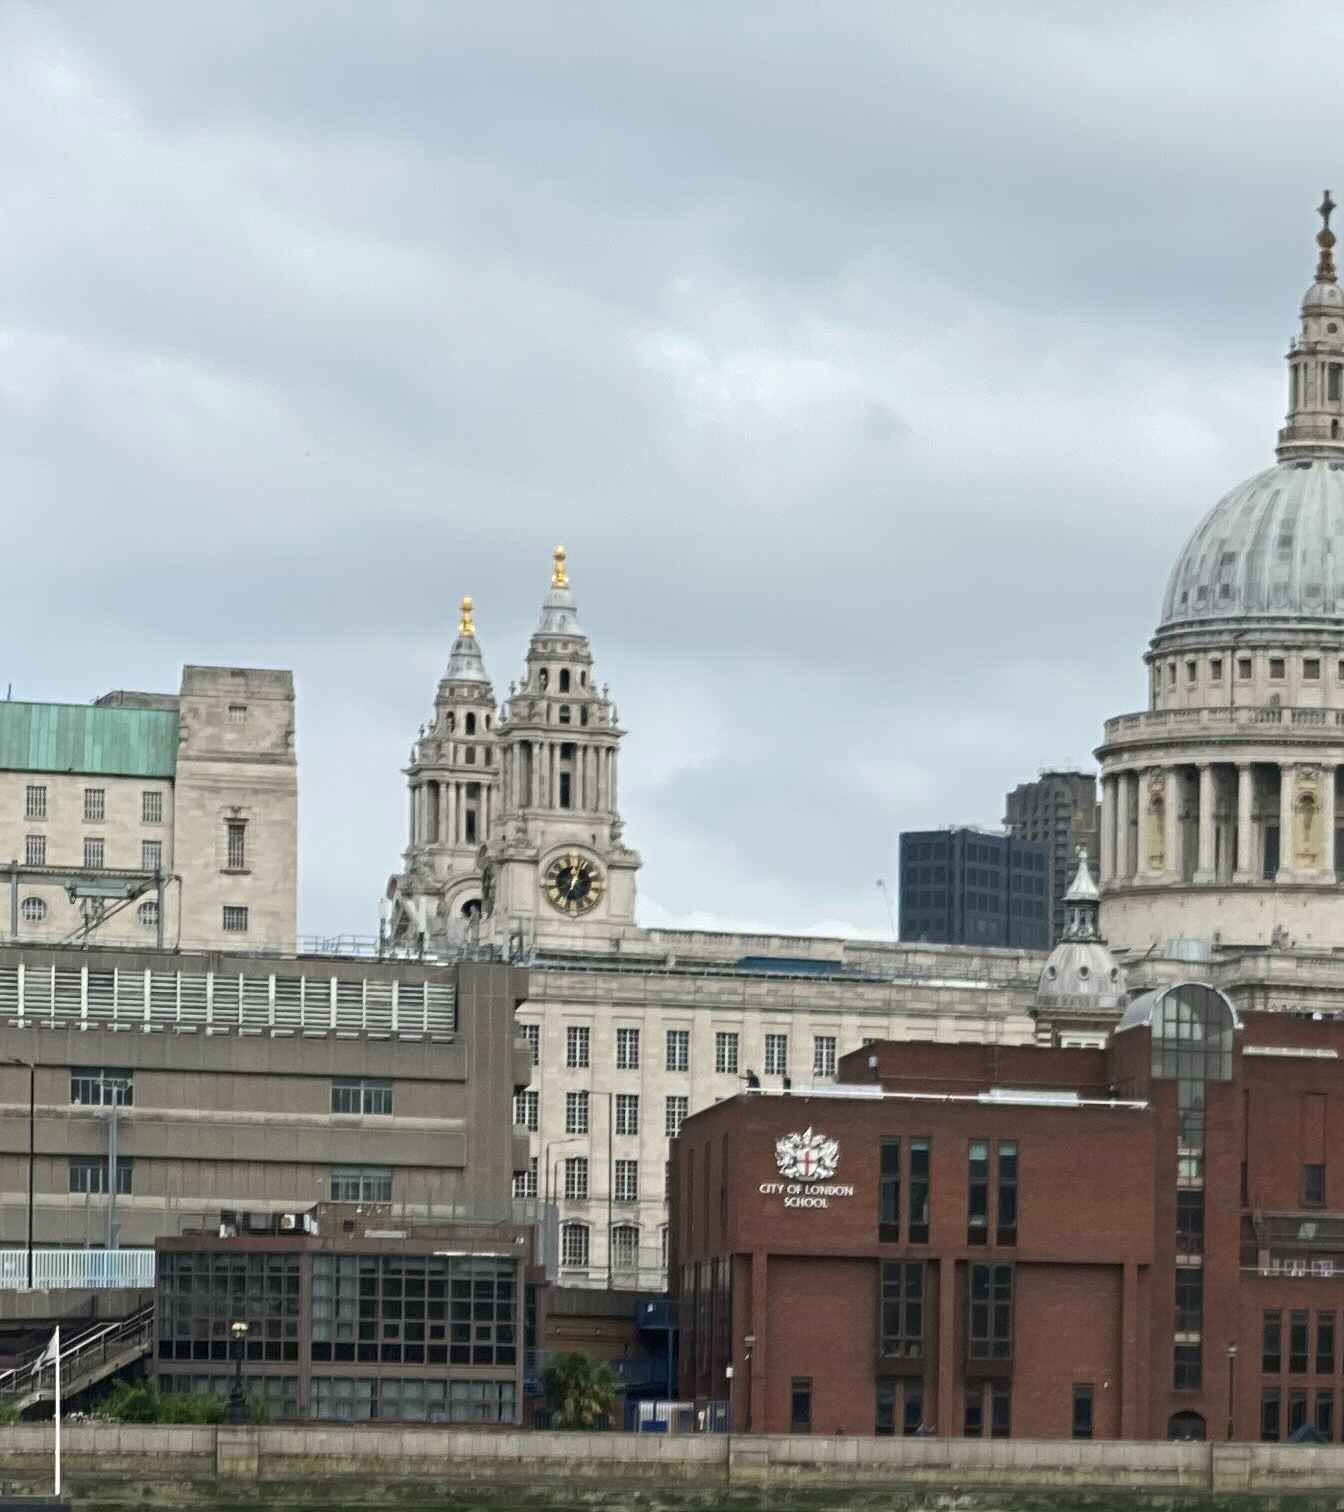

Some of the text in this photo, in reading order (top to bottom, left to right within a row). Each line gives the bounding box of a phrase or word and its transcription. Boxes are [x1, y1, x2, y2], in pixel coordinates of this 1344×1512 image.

[759, 1183, 855, 1196] CITY OF LONDON
[784, 1197, 829, 1208] SCHOOL
